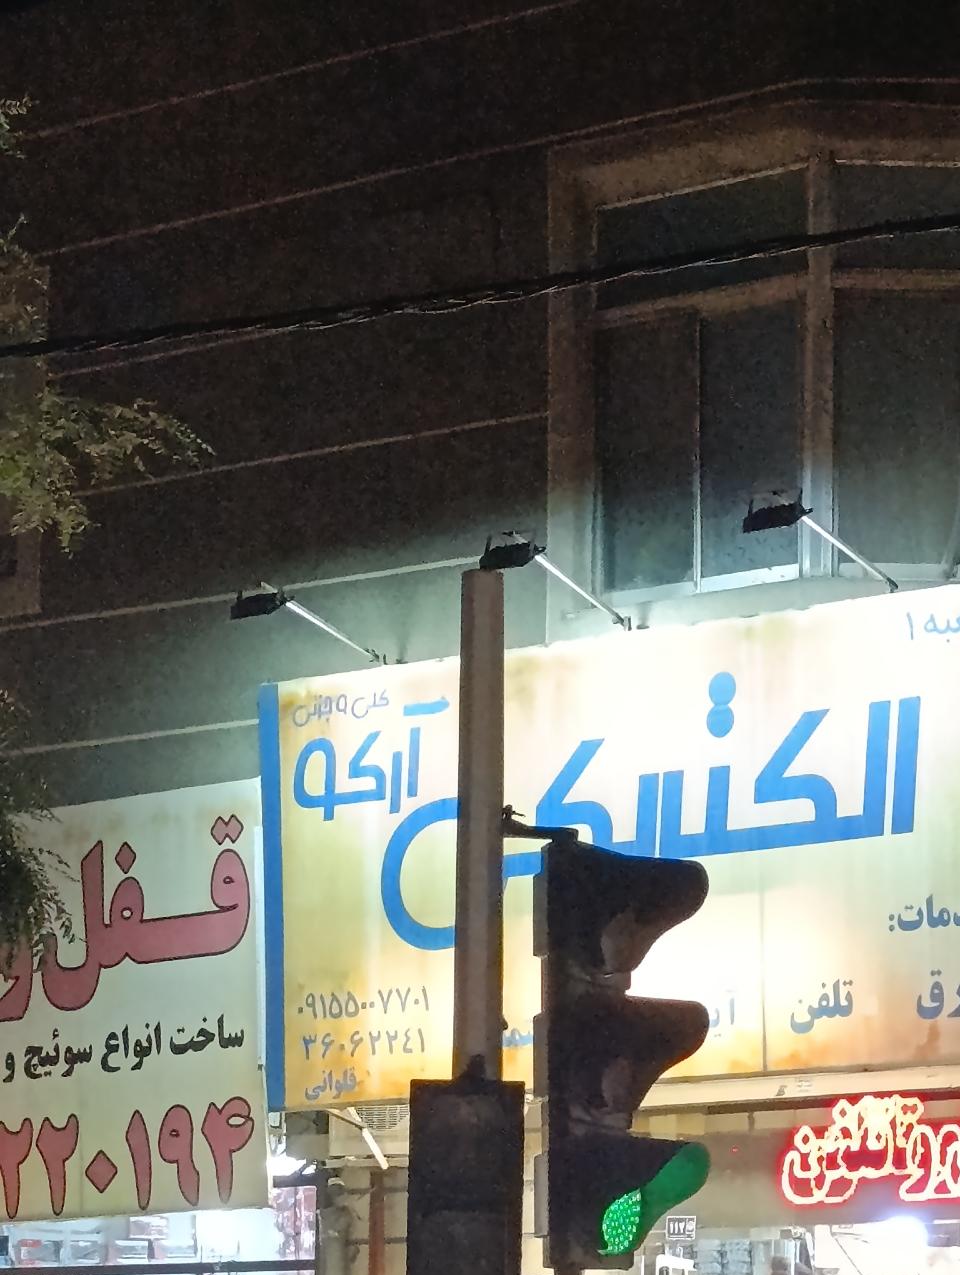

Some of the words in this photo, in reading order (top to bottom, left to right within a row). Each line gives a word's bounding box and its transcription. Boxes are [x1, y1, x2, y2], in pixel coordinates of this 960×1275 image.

[905, 611, 915, 641] ۱
[335, 693, 348, 716] و
[351, 688, 390, 719] کلی
[293, 695, 451, 823] آرکو
[40, 813, 251, 1011] قفل
[790, 977, 854, 1034] تلفن
[23, 1027, 94, 1080] سوئیچ
[100, 1020, 162, 1073] انواع
[170, 1014, 245, 1056] ساخت
[2, 1053, 17, 1083] و
